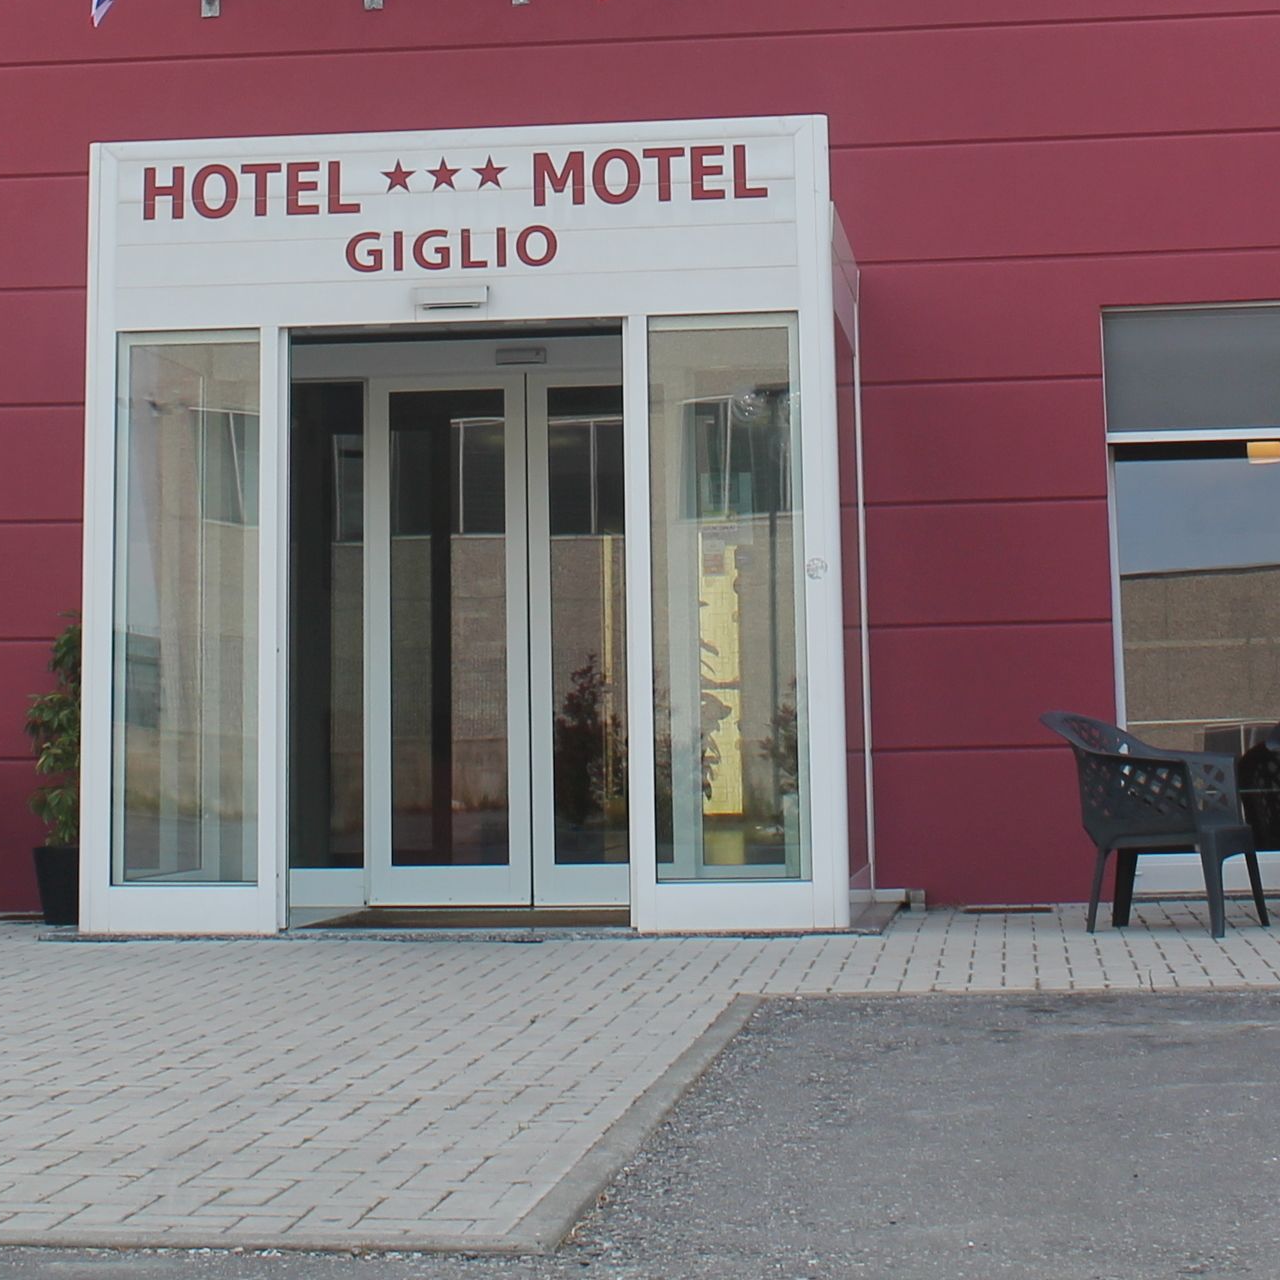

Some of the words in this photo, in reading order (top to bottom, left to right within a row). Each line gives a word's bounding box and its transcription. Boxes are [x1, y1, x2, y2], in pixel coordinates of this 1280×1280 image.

[143, 160, 361, 220] HOTEL
[533, 144, 769, 207] MOTEL
[345, 224, 558, 273] GIGLIO
